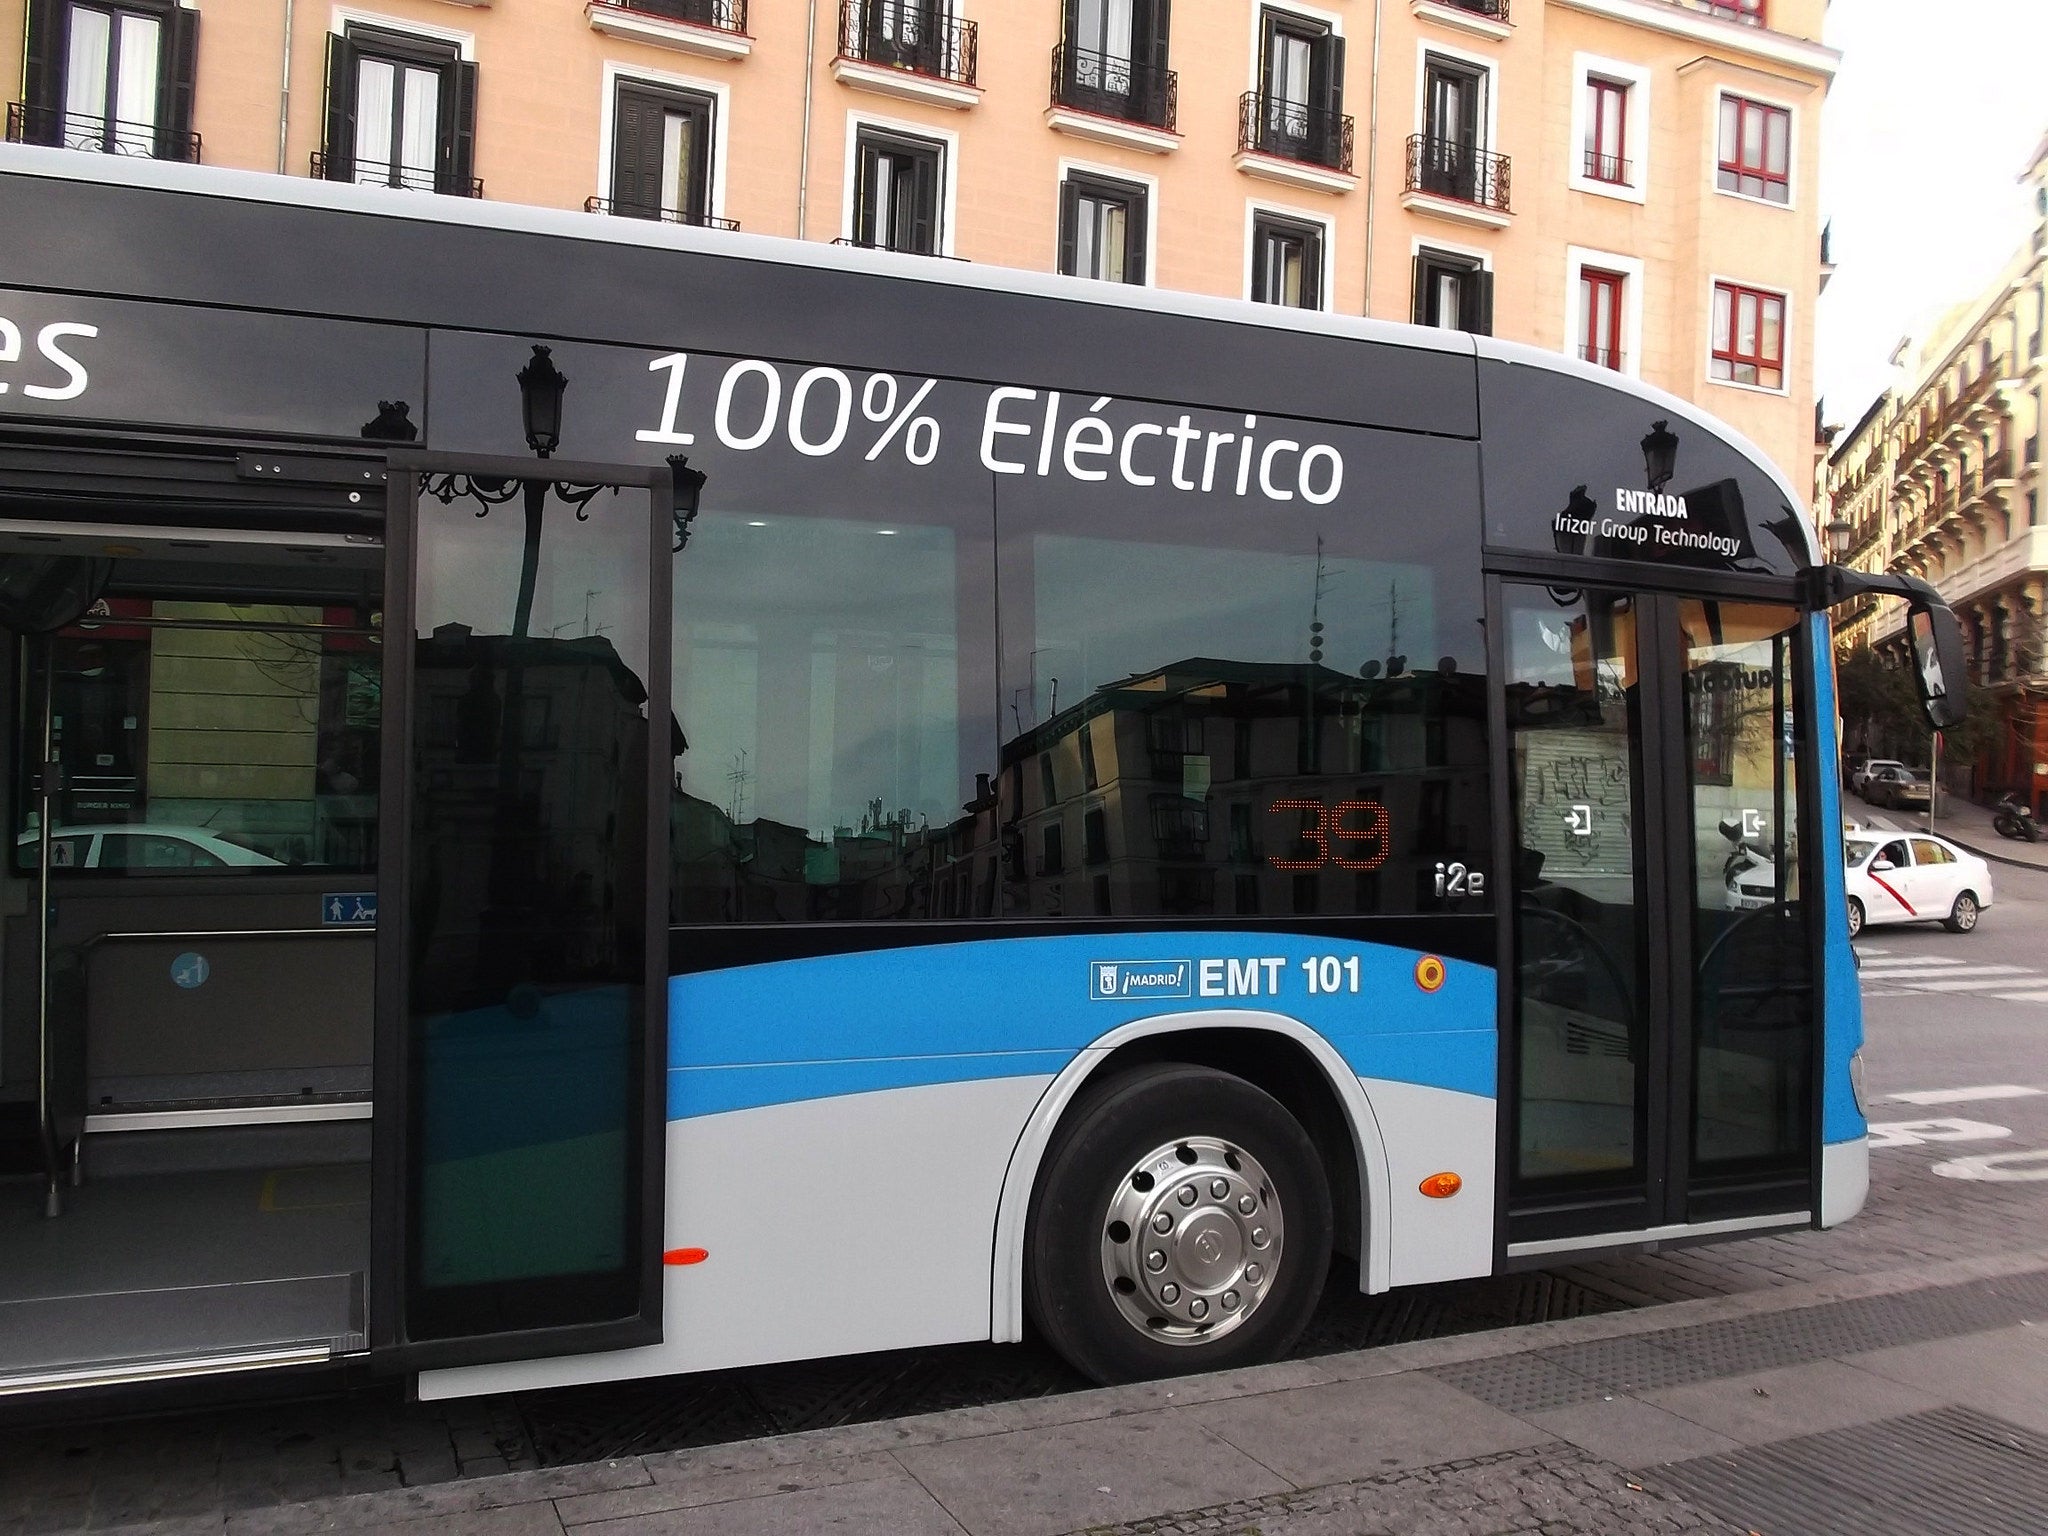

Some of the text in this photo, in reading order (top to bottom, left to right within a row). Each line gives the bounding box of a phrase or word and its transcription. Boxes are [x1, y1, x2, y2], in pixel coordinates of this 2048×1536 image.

[634, 352, 1345, 506] 100% Eléctrico
[1616, 488, 1689, 520] ENTRADA
[1555, 513, 1741, 557] Irizar Group Technology
[1268, 799, 1390, 870] 39
[1434, 861, 1485, 898] i2e
[1199, 955, 1360, 997] EMT 101
